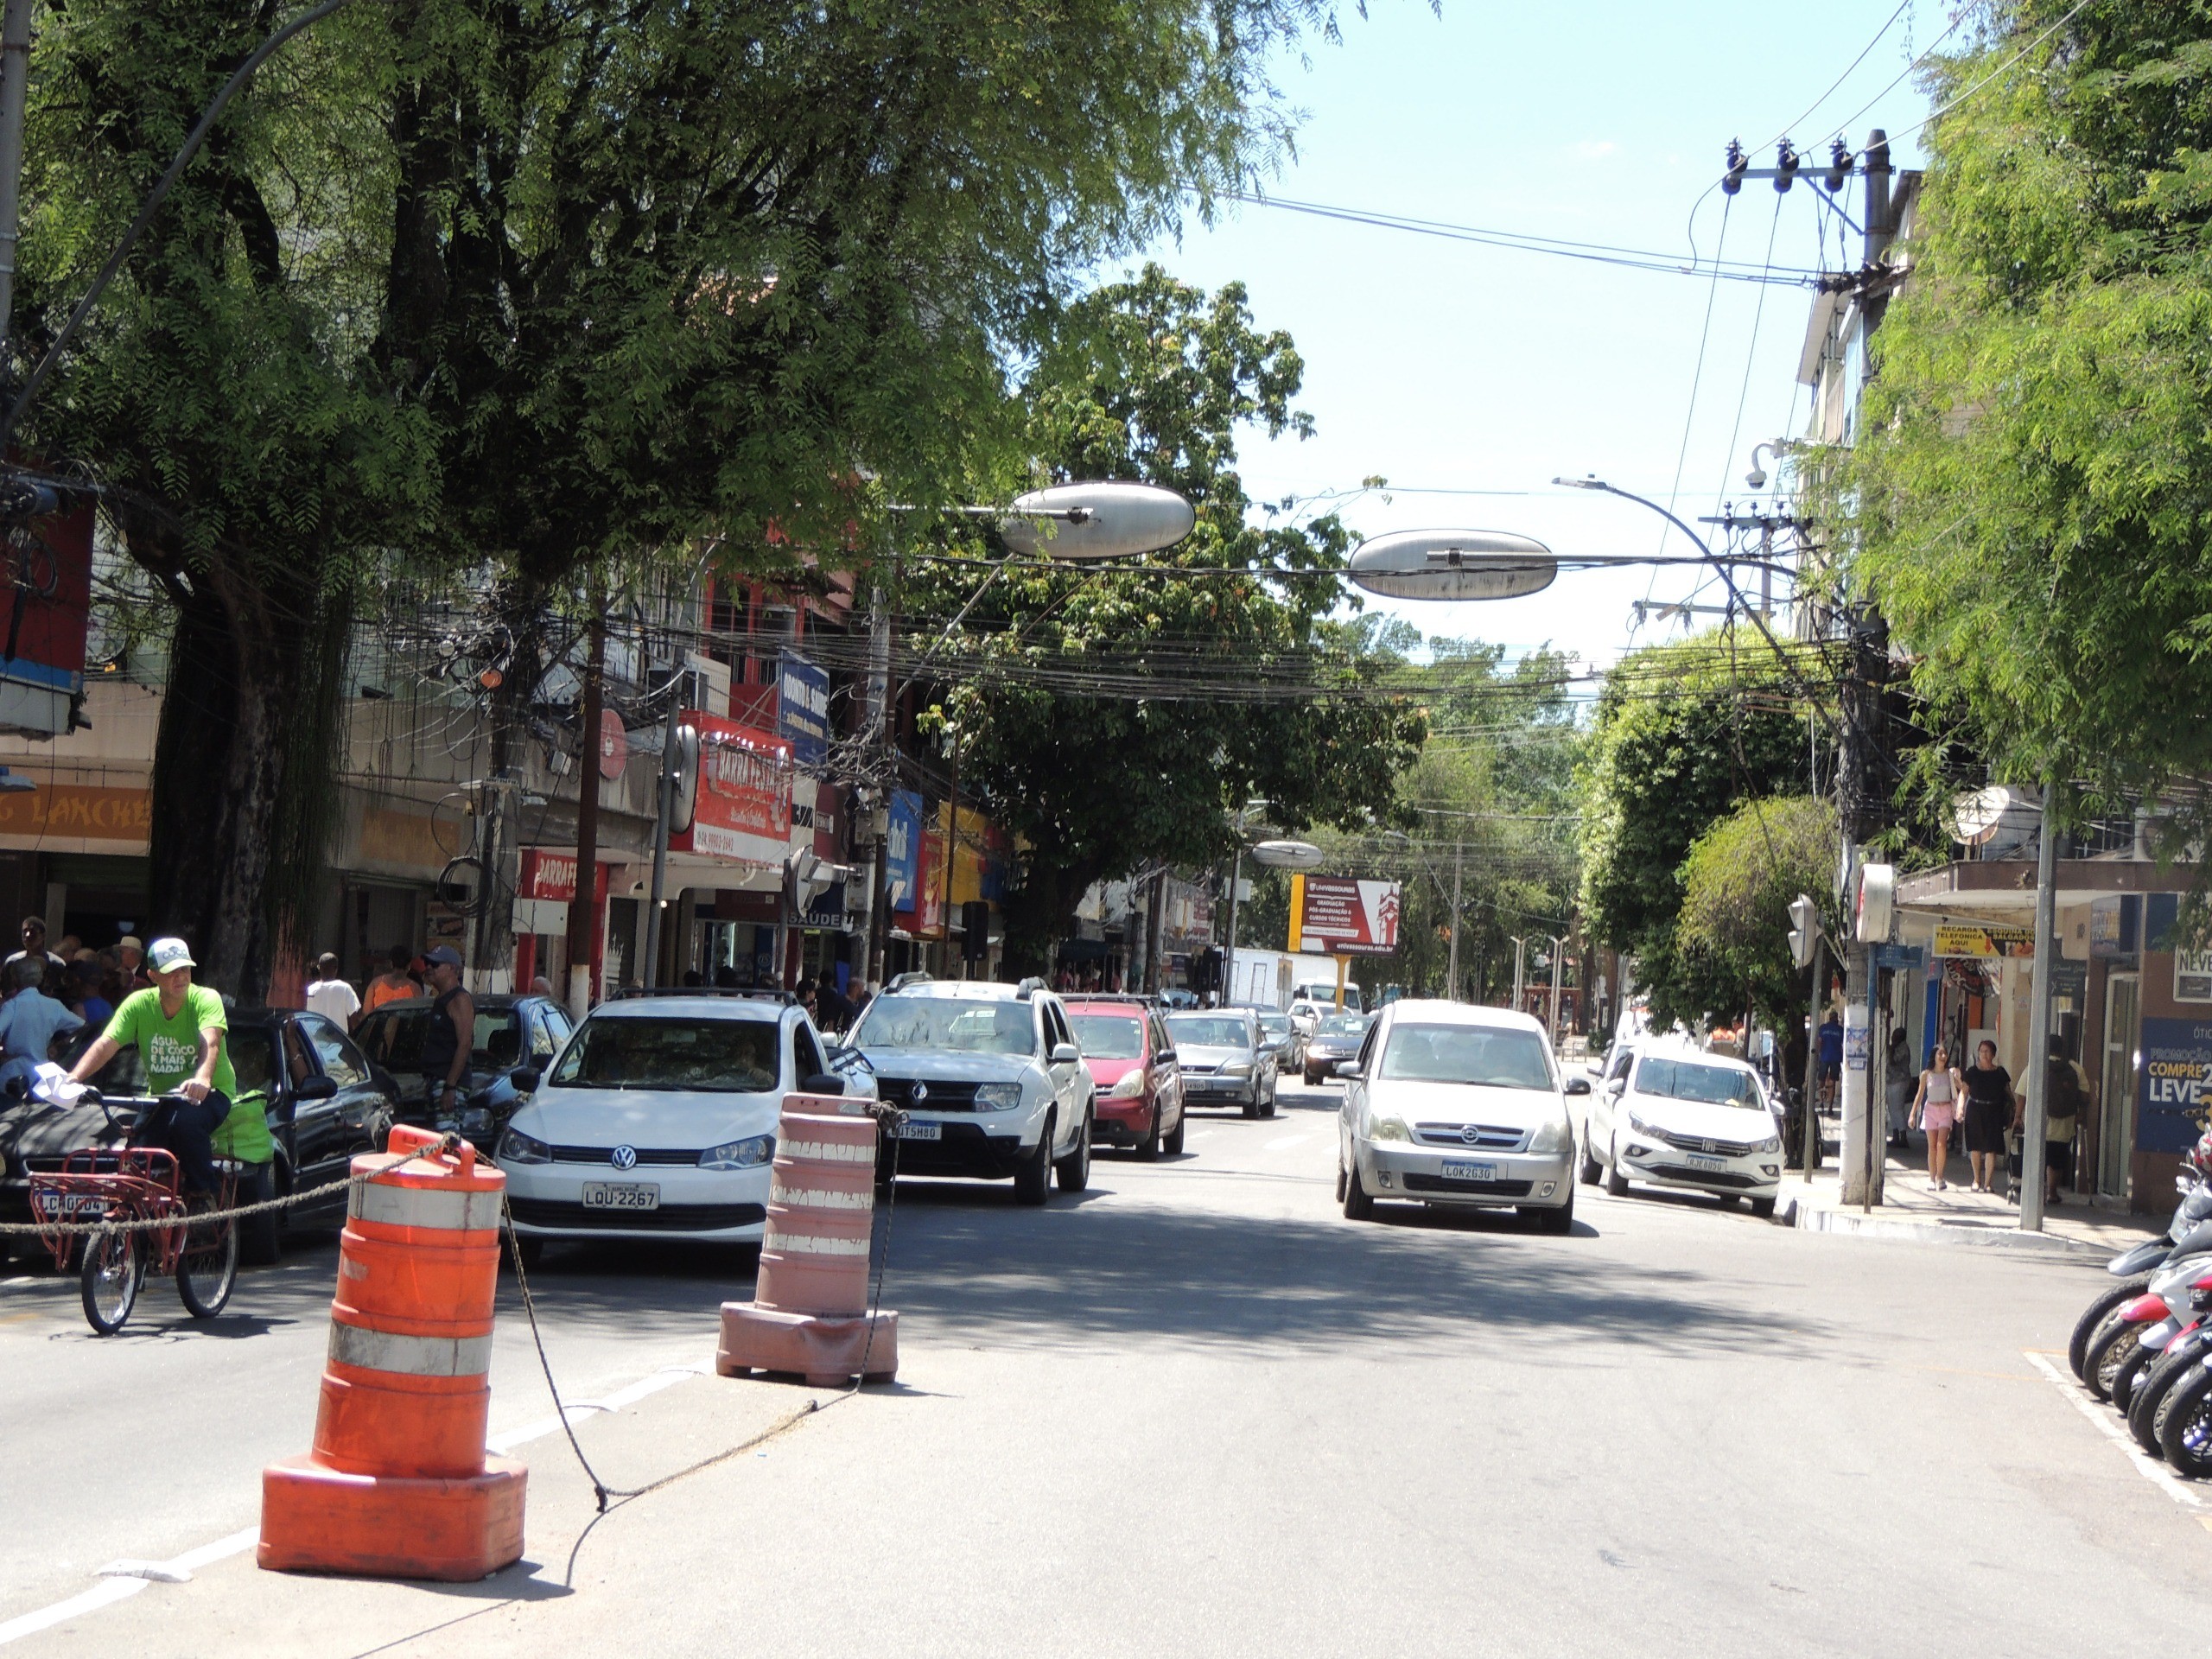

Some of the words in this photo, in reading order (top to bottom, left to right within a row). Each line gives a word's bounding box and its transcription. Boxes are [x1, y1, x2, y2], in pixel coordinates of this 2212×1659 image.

[1336, 942, 1394, 953] univassouras.edu.br
[150, 1033, 178, 1046] ÁGUA
[150, 1046, 164, 1054] DE
[168, 1045, 195, 1056] COCO
[2150, 1047, 2212, 1062] PROMOÇÃO
[150, 1055, 157, 1064] E
[161, 1055, 186, 1065] MAIS
[2148, 1062, 2202, 1079] COMPRE
[2149, 1078, 2202, 1104] LEVE
